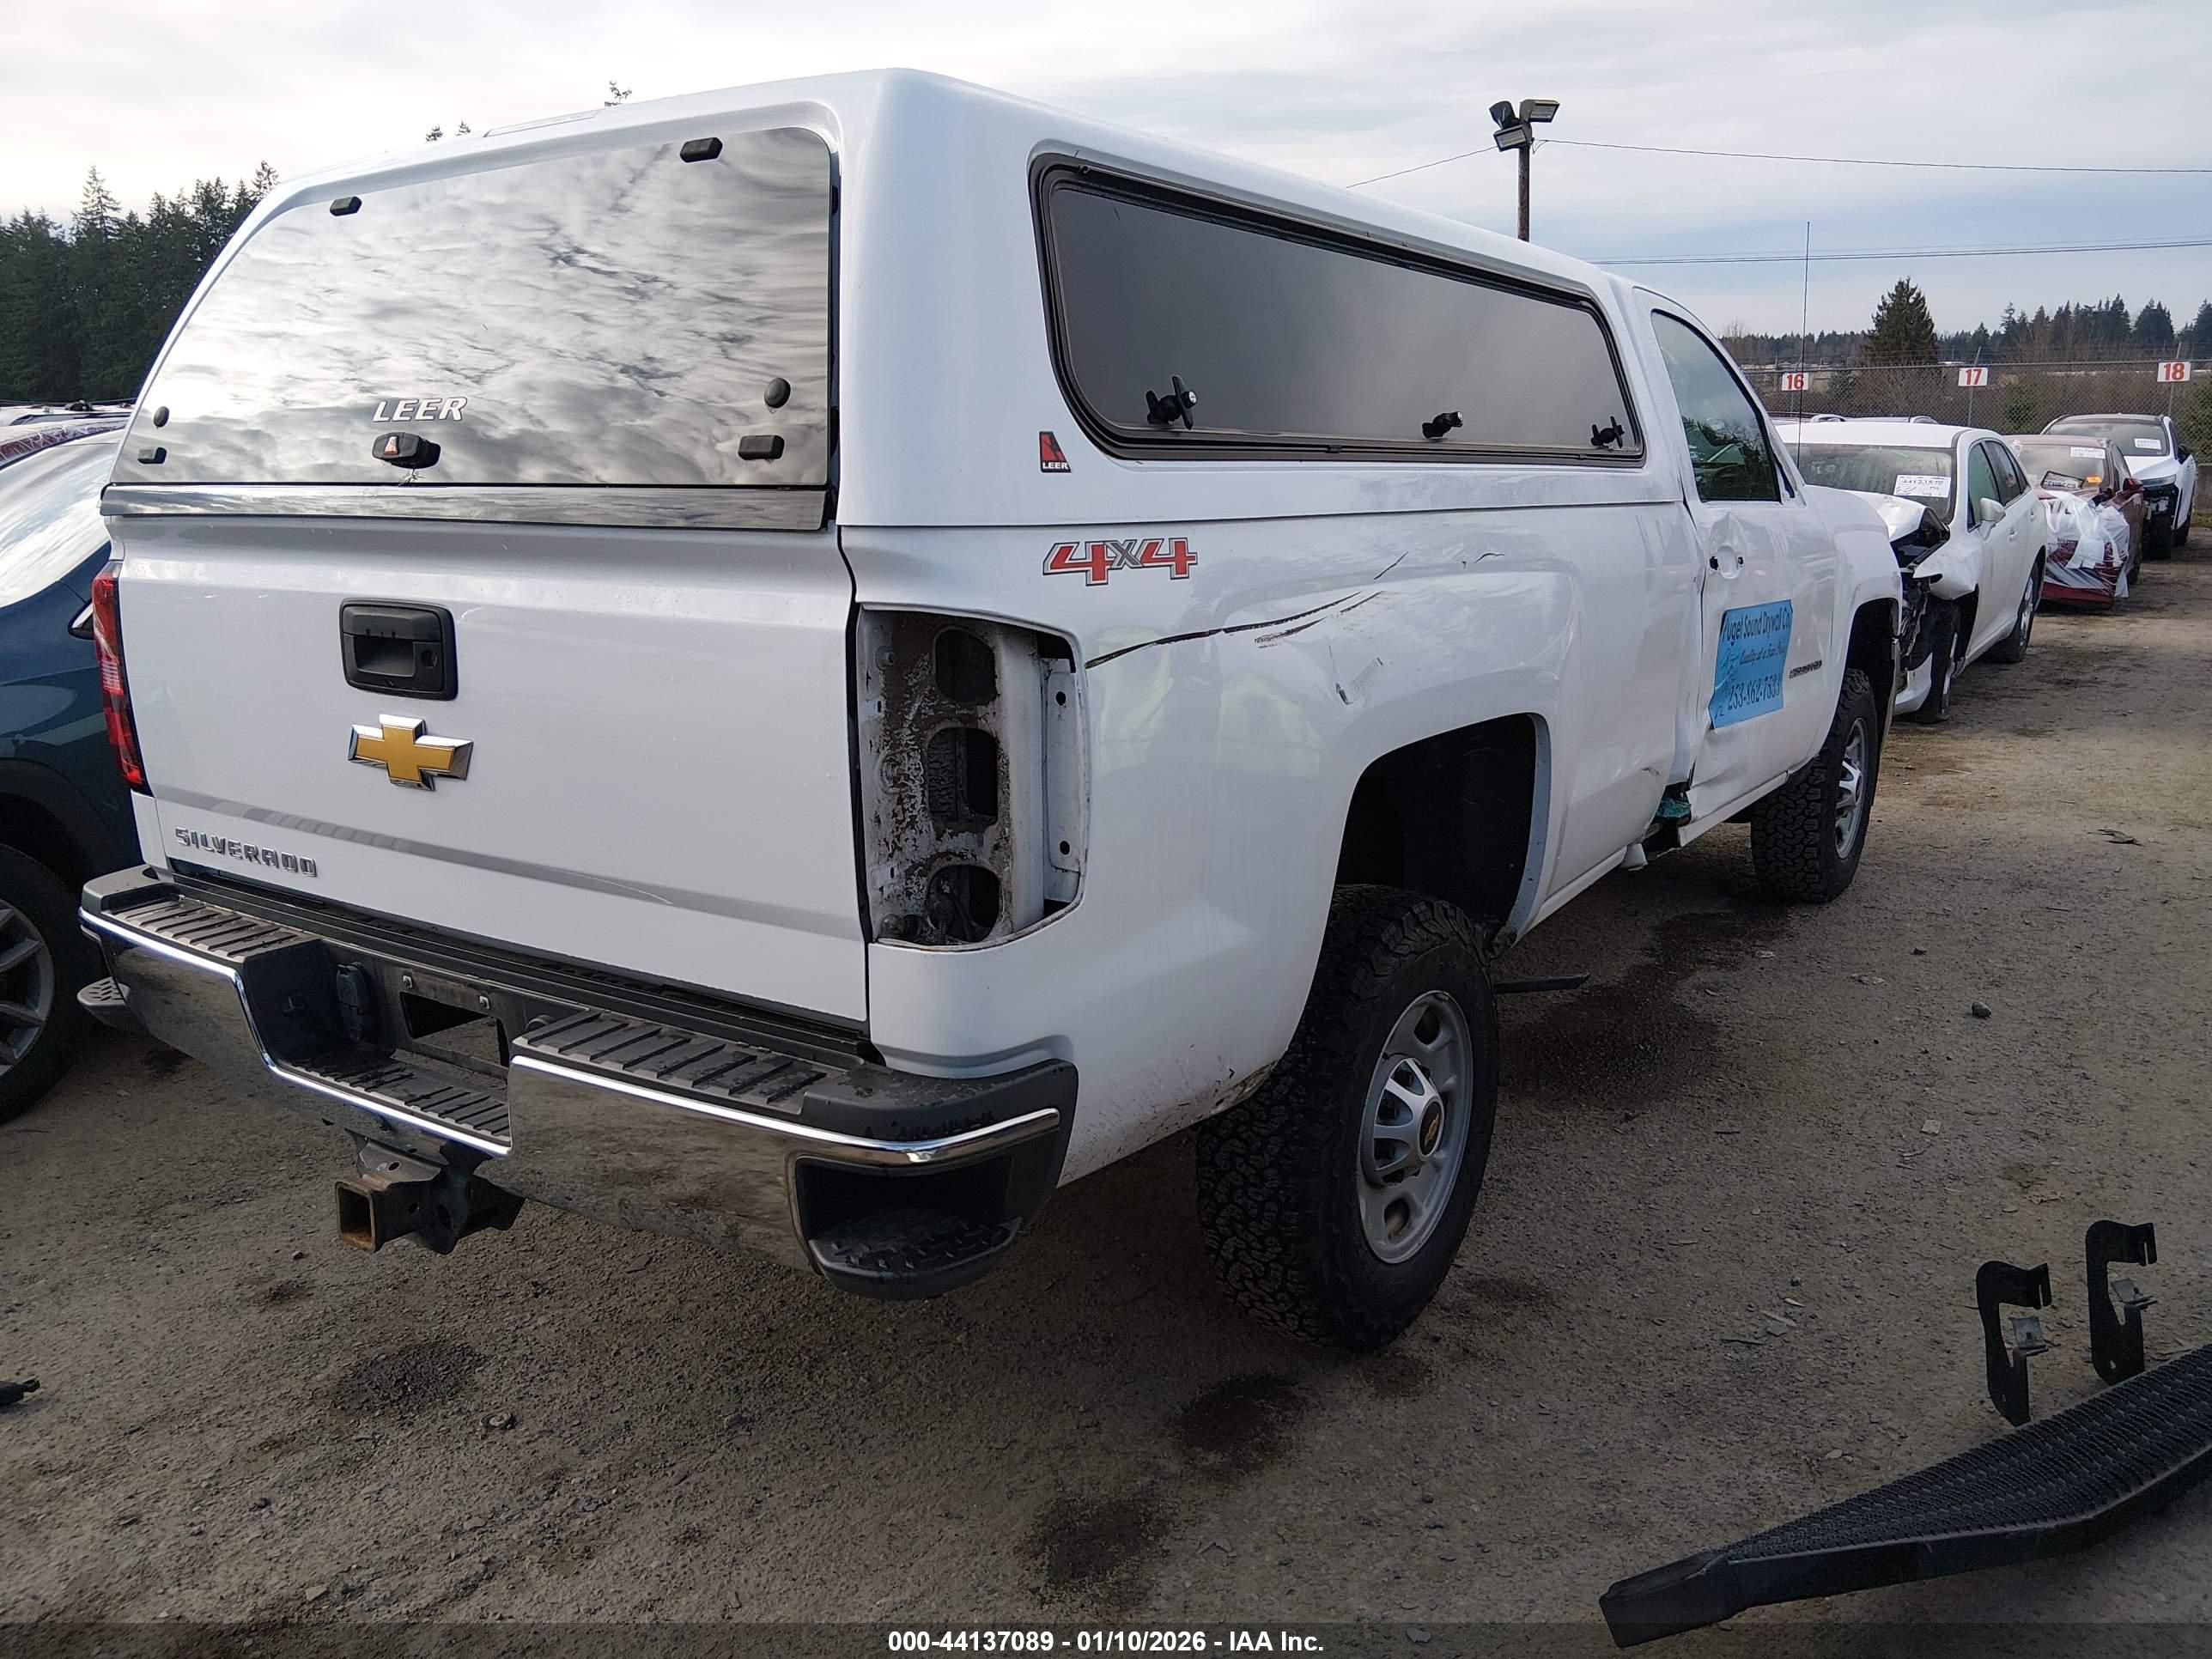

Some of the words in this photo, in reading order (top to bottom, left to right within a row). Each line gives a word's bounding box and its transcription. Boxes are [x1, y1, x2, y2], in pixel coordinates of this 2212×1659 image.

[1965, 368, 1982, 386] 17
[2163, 363, 2185, 380] 18
[1786, 374, 1804, 390] 16
[372, 396, 468, 422] LEER
[1042, 461, 1069, 470] LEER
[1743, 612, 1762, 638] Sound
[1762, 609, 1782, 637] Drywall
[174, 826, 319, 878] SILVERADO
